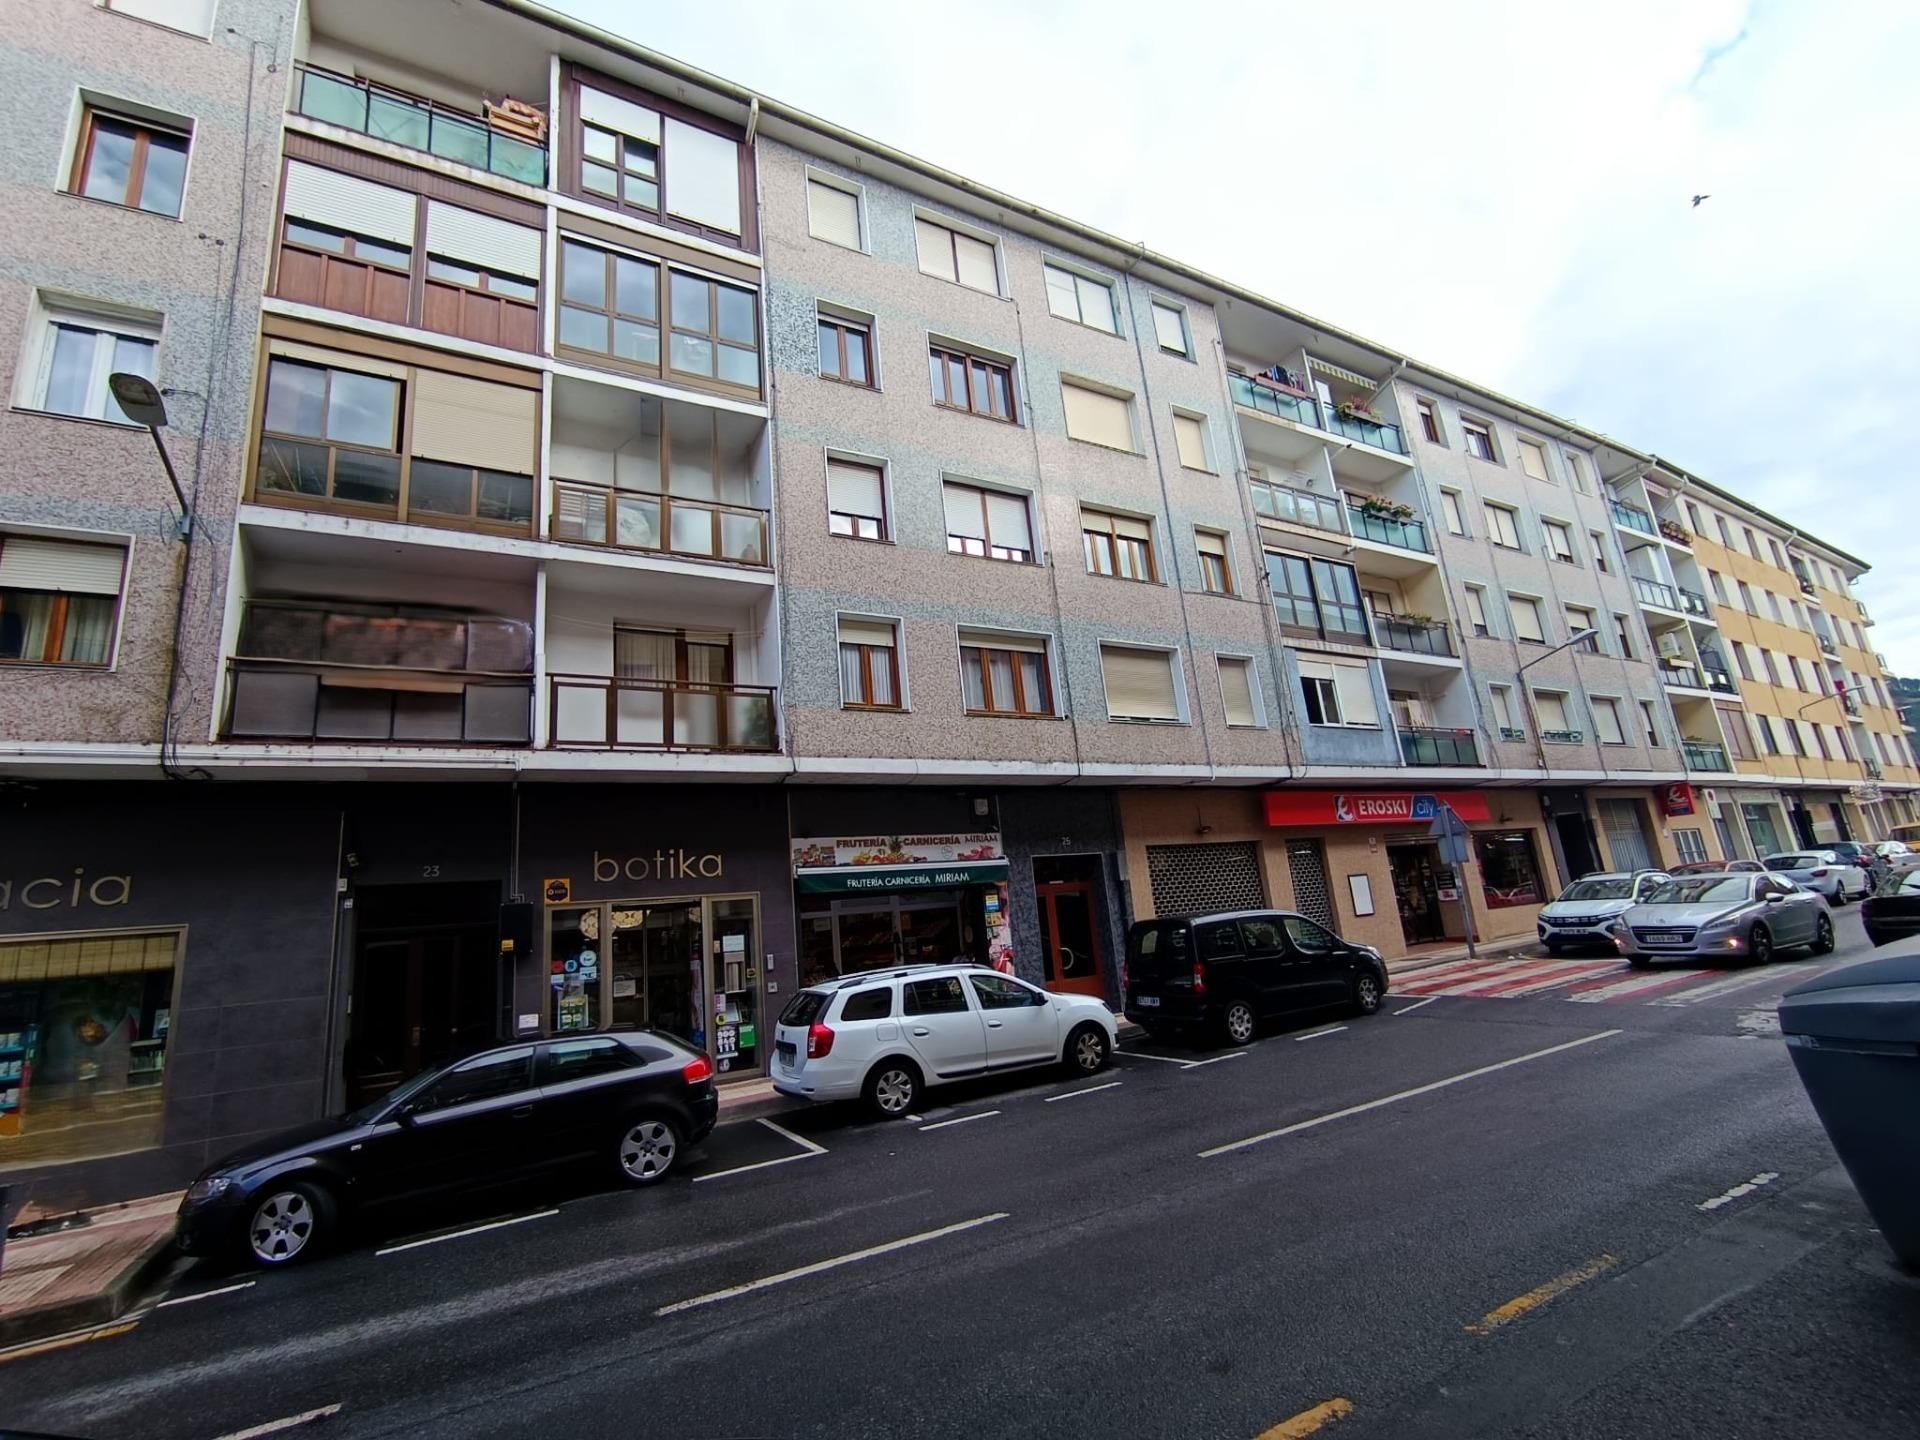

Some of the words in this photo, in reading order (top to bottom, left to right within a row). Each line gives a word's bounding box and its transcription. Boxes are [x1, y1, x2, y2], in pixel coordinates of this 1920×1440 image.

[1358, 799, 1407, 815] EROSKI
[1416, 800, 1433, 818] city
[836, 837, 887, 849] FRUTERÍA
[903, 835, 961, 847] CARNICERÍA
[964, 834, 998, 844] MIRIAM
[423, 864, 440, 878] 23
[593, 848, 723, 882] botika
[847, 877, 884, 888] FRUTERÍA
[885, 874, 931, 887] CARNICERÍA
[935, 872, 970, 884] MIRIAM
